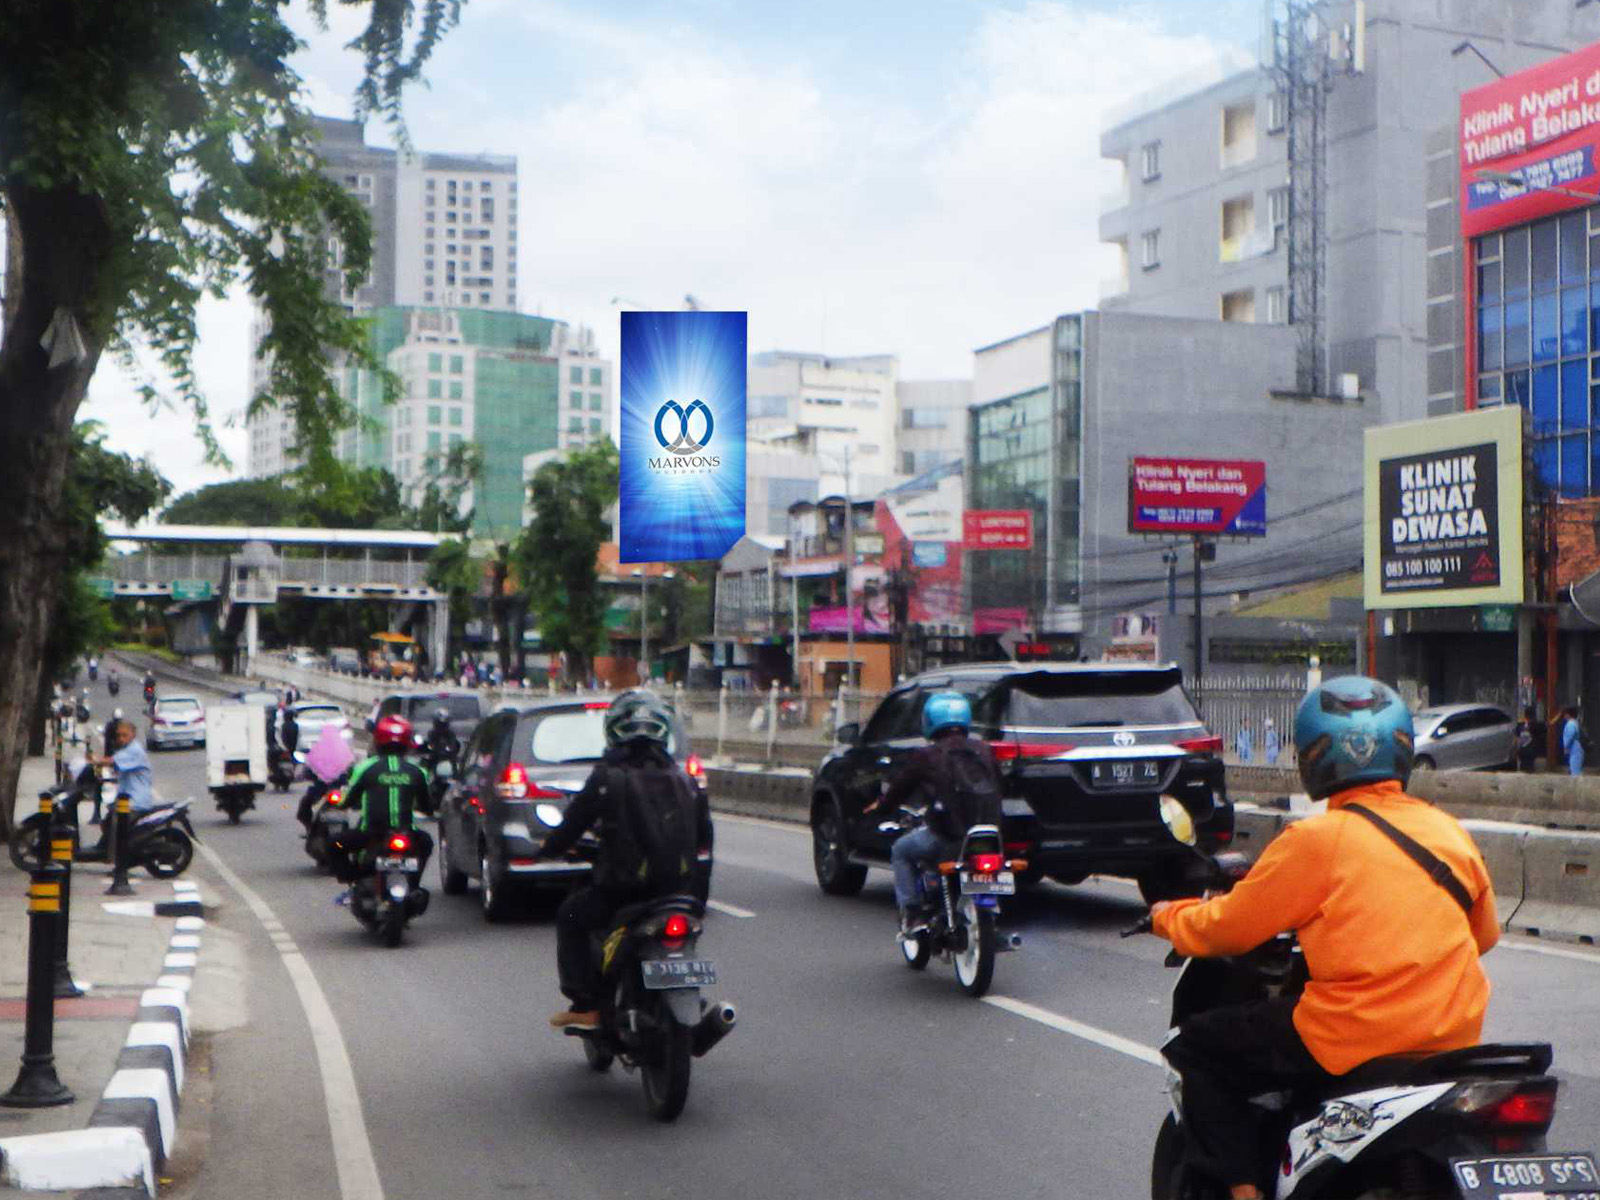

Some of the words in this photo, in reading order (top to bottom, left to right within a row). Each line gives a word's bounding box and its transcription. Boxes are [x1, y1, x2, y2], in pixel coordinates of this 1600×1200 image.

[1464, 102, 1515, 139] Klinik
[1520, 76, 1579, 118] Nyeri
[648, 456, 721, 469] MARVONS
[1136, 465, 1174, 479] Klinik
[1177, 466, 1214, 482] Nyeri
[1217, 468, 1242, 480] dan
[1400, 456, 1477, 491] KLINIK
[1137, 479, 1182, 494] Tulang
[1185, 480, 1247, 496] Belakang
[1402, 483, 1476, 517] SUNAT
[1392, 508, 1488, 543] DEWASA
[1386, 561, 1403, 577] 085
[1406, 559, 1422, 575] 100
[1425, 557, 1442, 573] 100
[1444, 555, 1461, 573] 111
[1461, 1166, 1480, 1189] B
[1493, 1163, 1544, 1185] 4808
